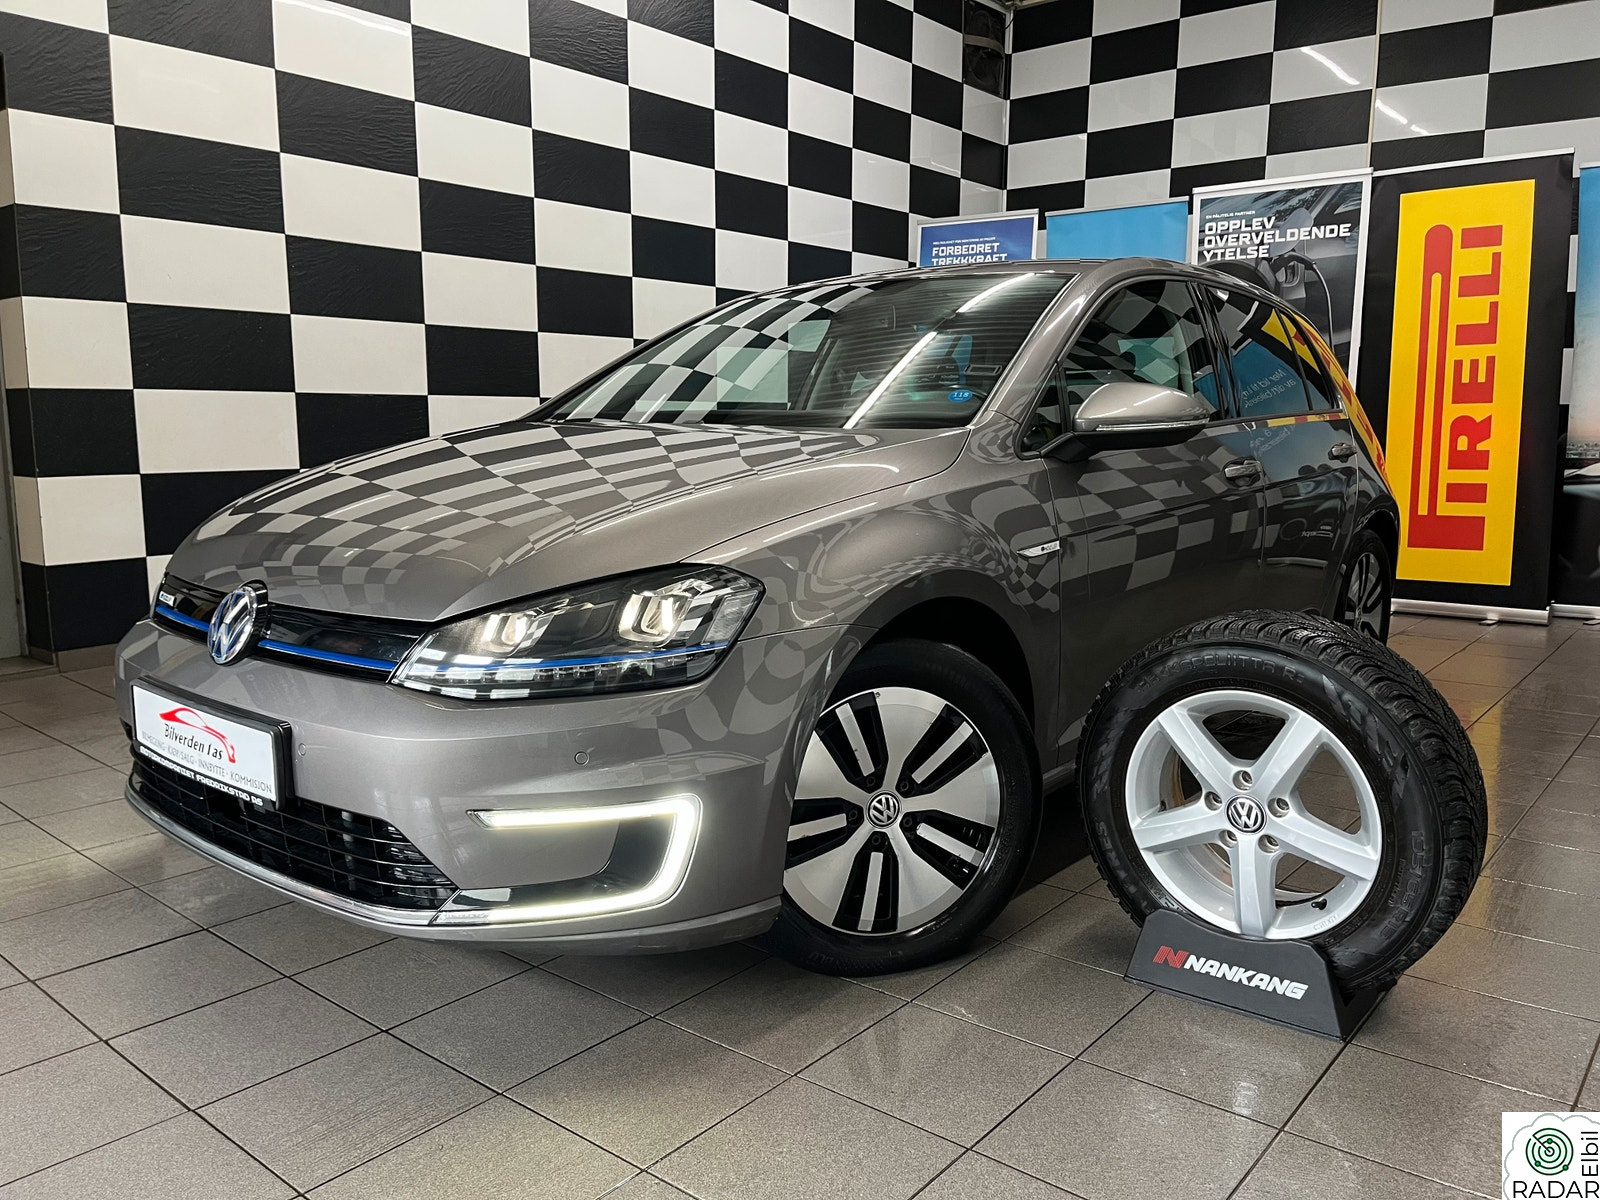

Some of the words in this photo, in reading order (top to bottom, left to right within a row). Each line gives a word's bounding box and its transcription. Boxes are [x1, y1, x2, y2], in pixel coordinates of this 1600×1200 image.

[1204, 224, 1352, 249] OVERVELDENDE
[1205, 216, 1276, 235] OPPLEV
[932, 242, 1000, 257] FORBEDRET
[1203, 244, 1270, 262] YTELSE
[1406, 224, 1504, 551] PIRELLI
[164, 723, 205, 753] Bilverden
[212, 748, 223, 760] as
[196, 774, 250, 803] FREDRIKSTAD
[1183, 954, 1309, 1000] NANKANG
